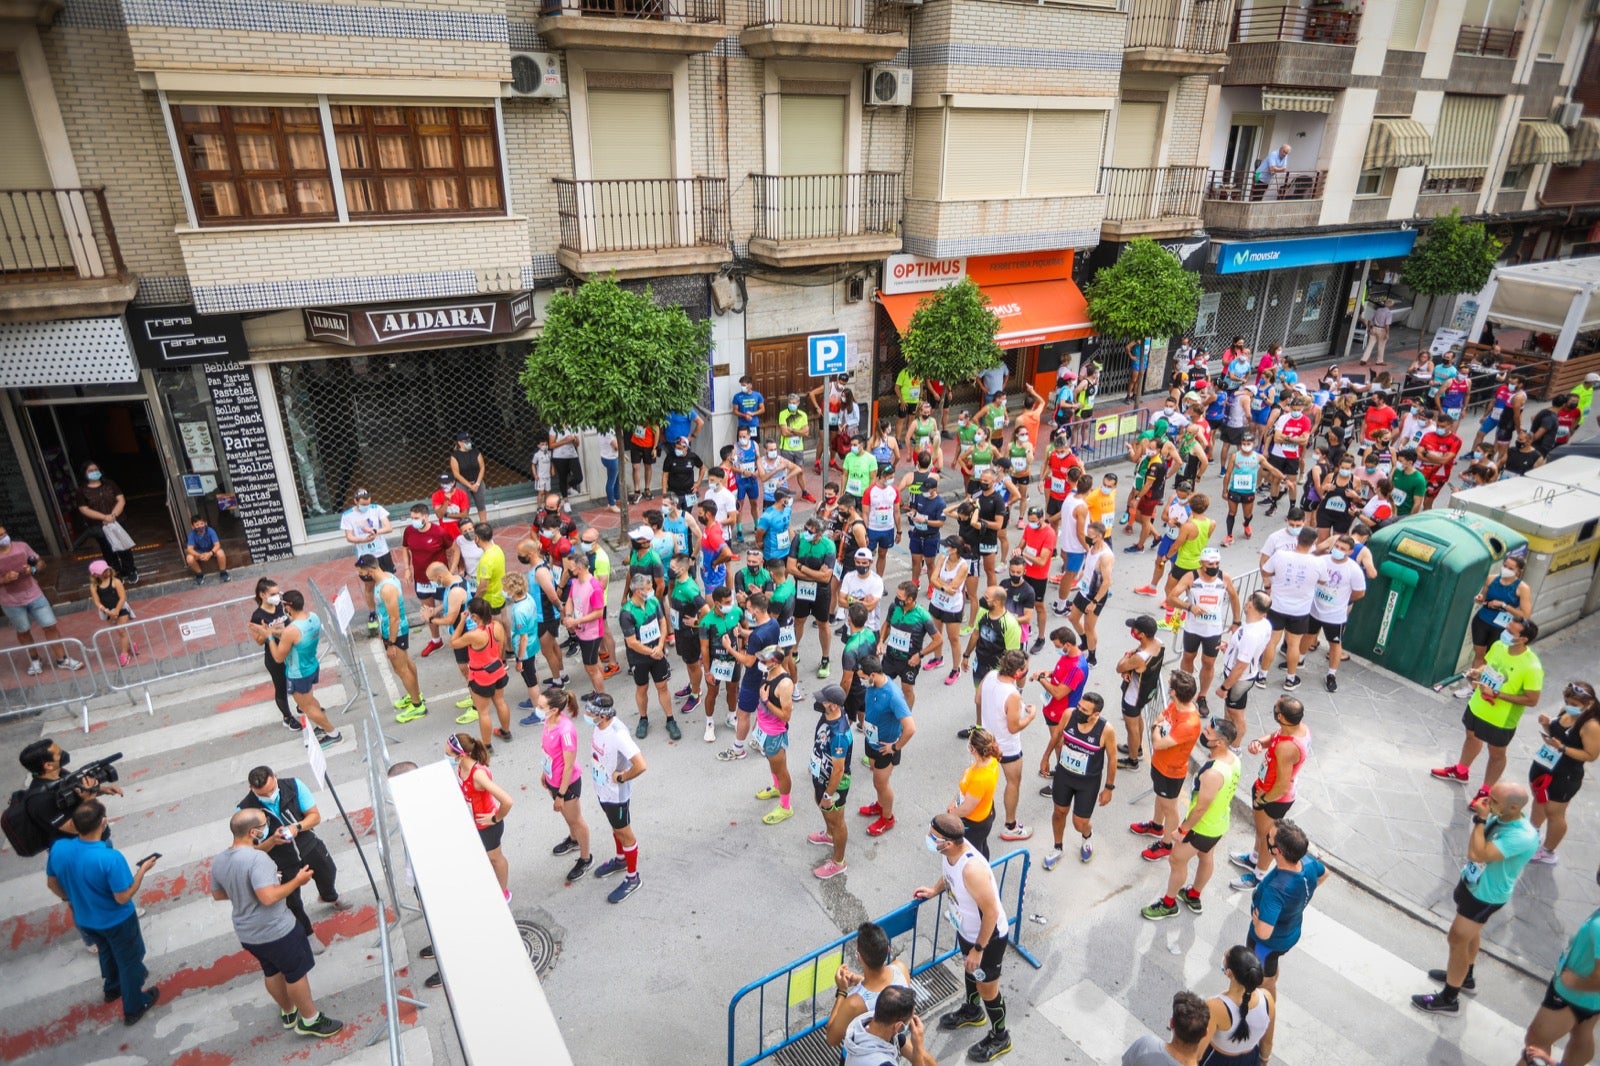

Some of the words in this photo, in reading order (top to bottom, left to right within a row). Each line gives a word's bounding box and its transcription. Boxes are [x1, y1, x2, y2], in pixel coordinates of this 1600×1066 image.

[1250, 250, 1280, 262] movistar
[894, 260, 960, 278] OPTIMUS
[314, 316, 345, 331] ALDARA
[383, 308, 486, 332] ALDARA
[145, 318, 195, 340] Crema
[161, 336, 229, 360] Caramelo
[816, 340, 838, 372] P
[204, 361, 244, 373] Bebidas
[208, 378, 222, 386] Pan
[224, 373, 250, 383] Tartas
[213, 386, 254, 398] Pasteles
[237, 395, 258, 404] Snack
[215, 404, 240, 416] Bollos
[234, 412, 262, 425] Snack
[240, 426, 264, 436] Tartas
[224, 437, 252, 450] Pan
[226, 450, 258, 460] Pasteles
[240, 462, 274, 474] Bollos
[249, 472, 275, 481] Helados
[234, 484, 261, 493] Bebidas
[239, 491, 271, 502] Tartas
[240, 508, 270, 518] Pasteles
[243, 515, 278, 527] Helados
[248, 538, 270, 546] Tartas
[800, 588, 815, 596] 1144
[1200, 612, 1217, 621] 1075
[892, 636, 906, 646] 1111
[1066, 756, 1082, 768] 178
